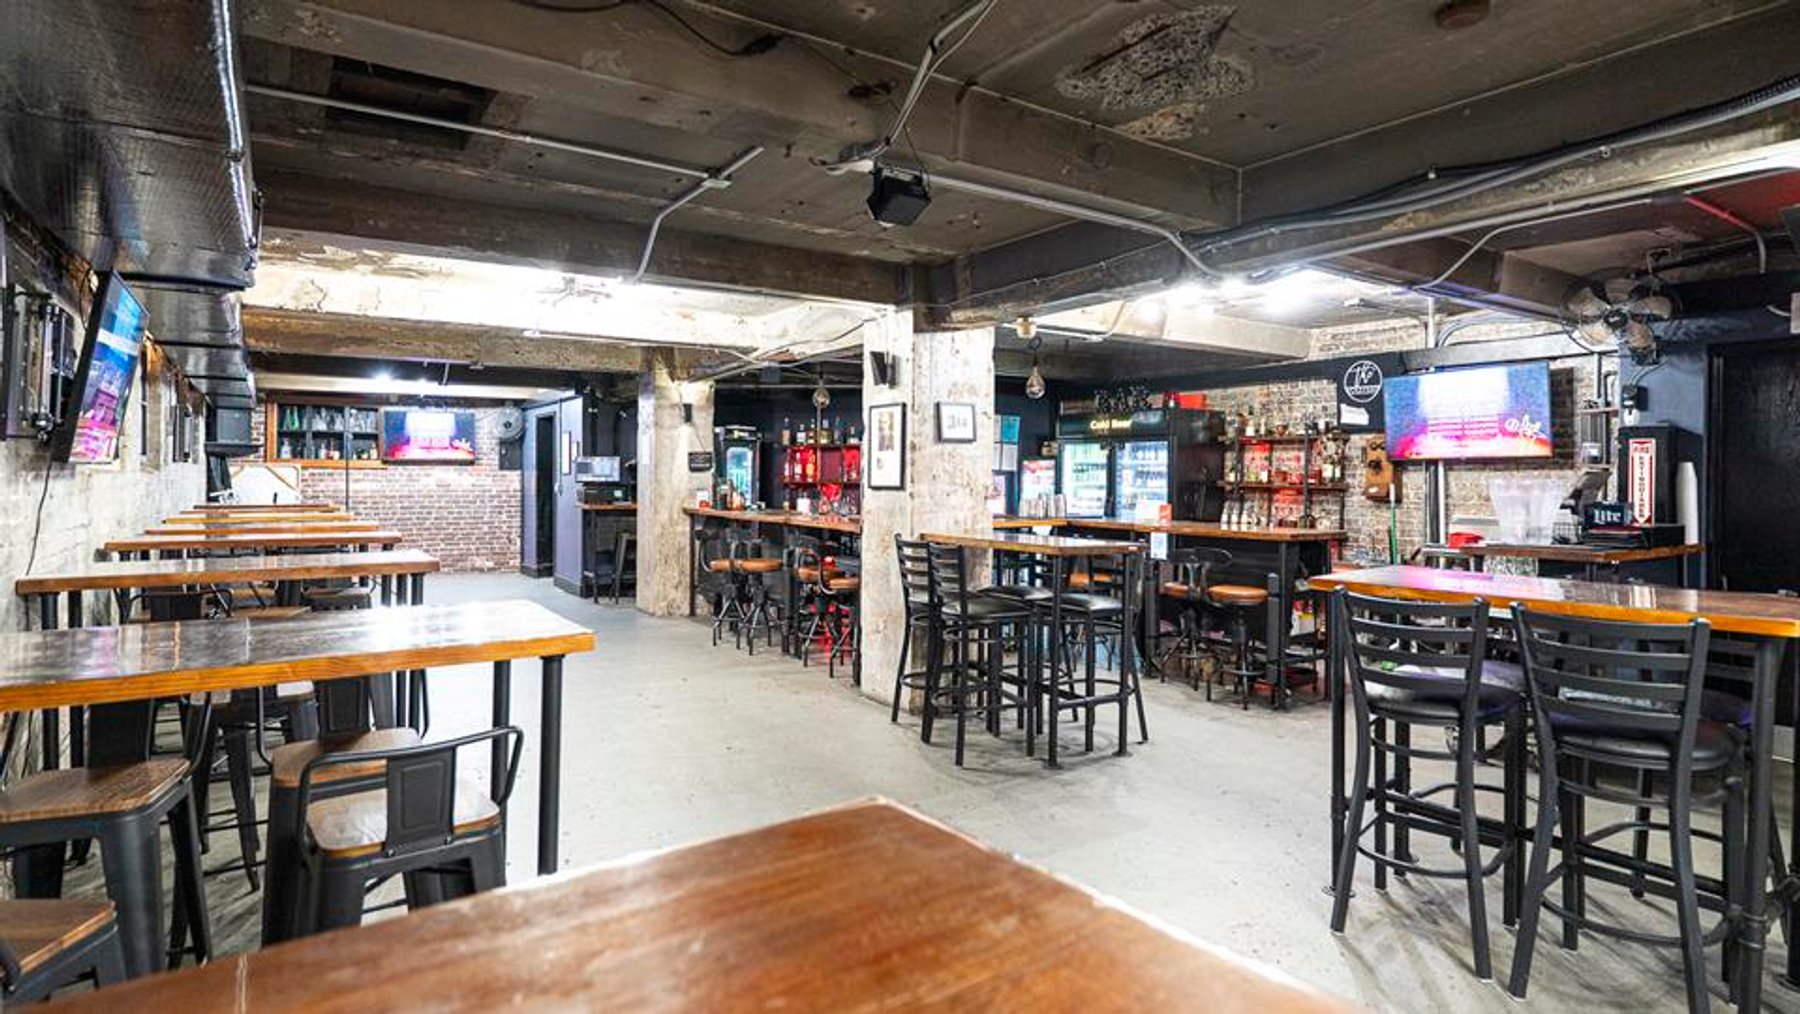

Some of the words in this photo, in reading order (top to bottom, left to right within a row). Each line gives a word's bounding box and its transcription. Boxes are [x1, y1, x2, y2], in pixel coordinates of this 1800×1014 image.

[1090, 419, 1110, 430] Cold
[1111, 418, 1132, 429] Beer
[1593, 509, 1621, 525] Lite
